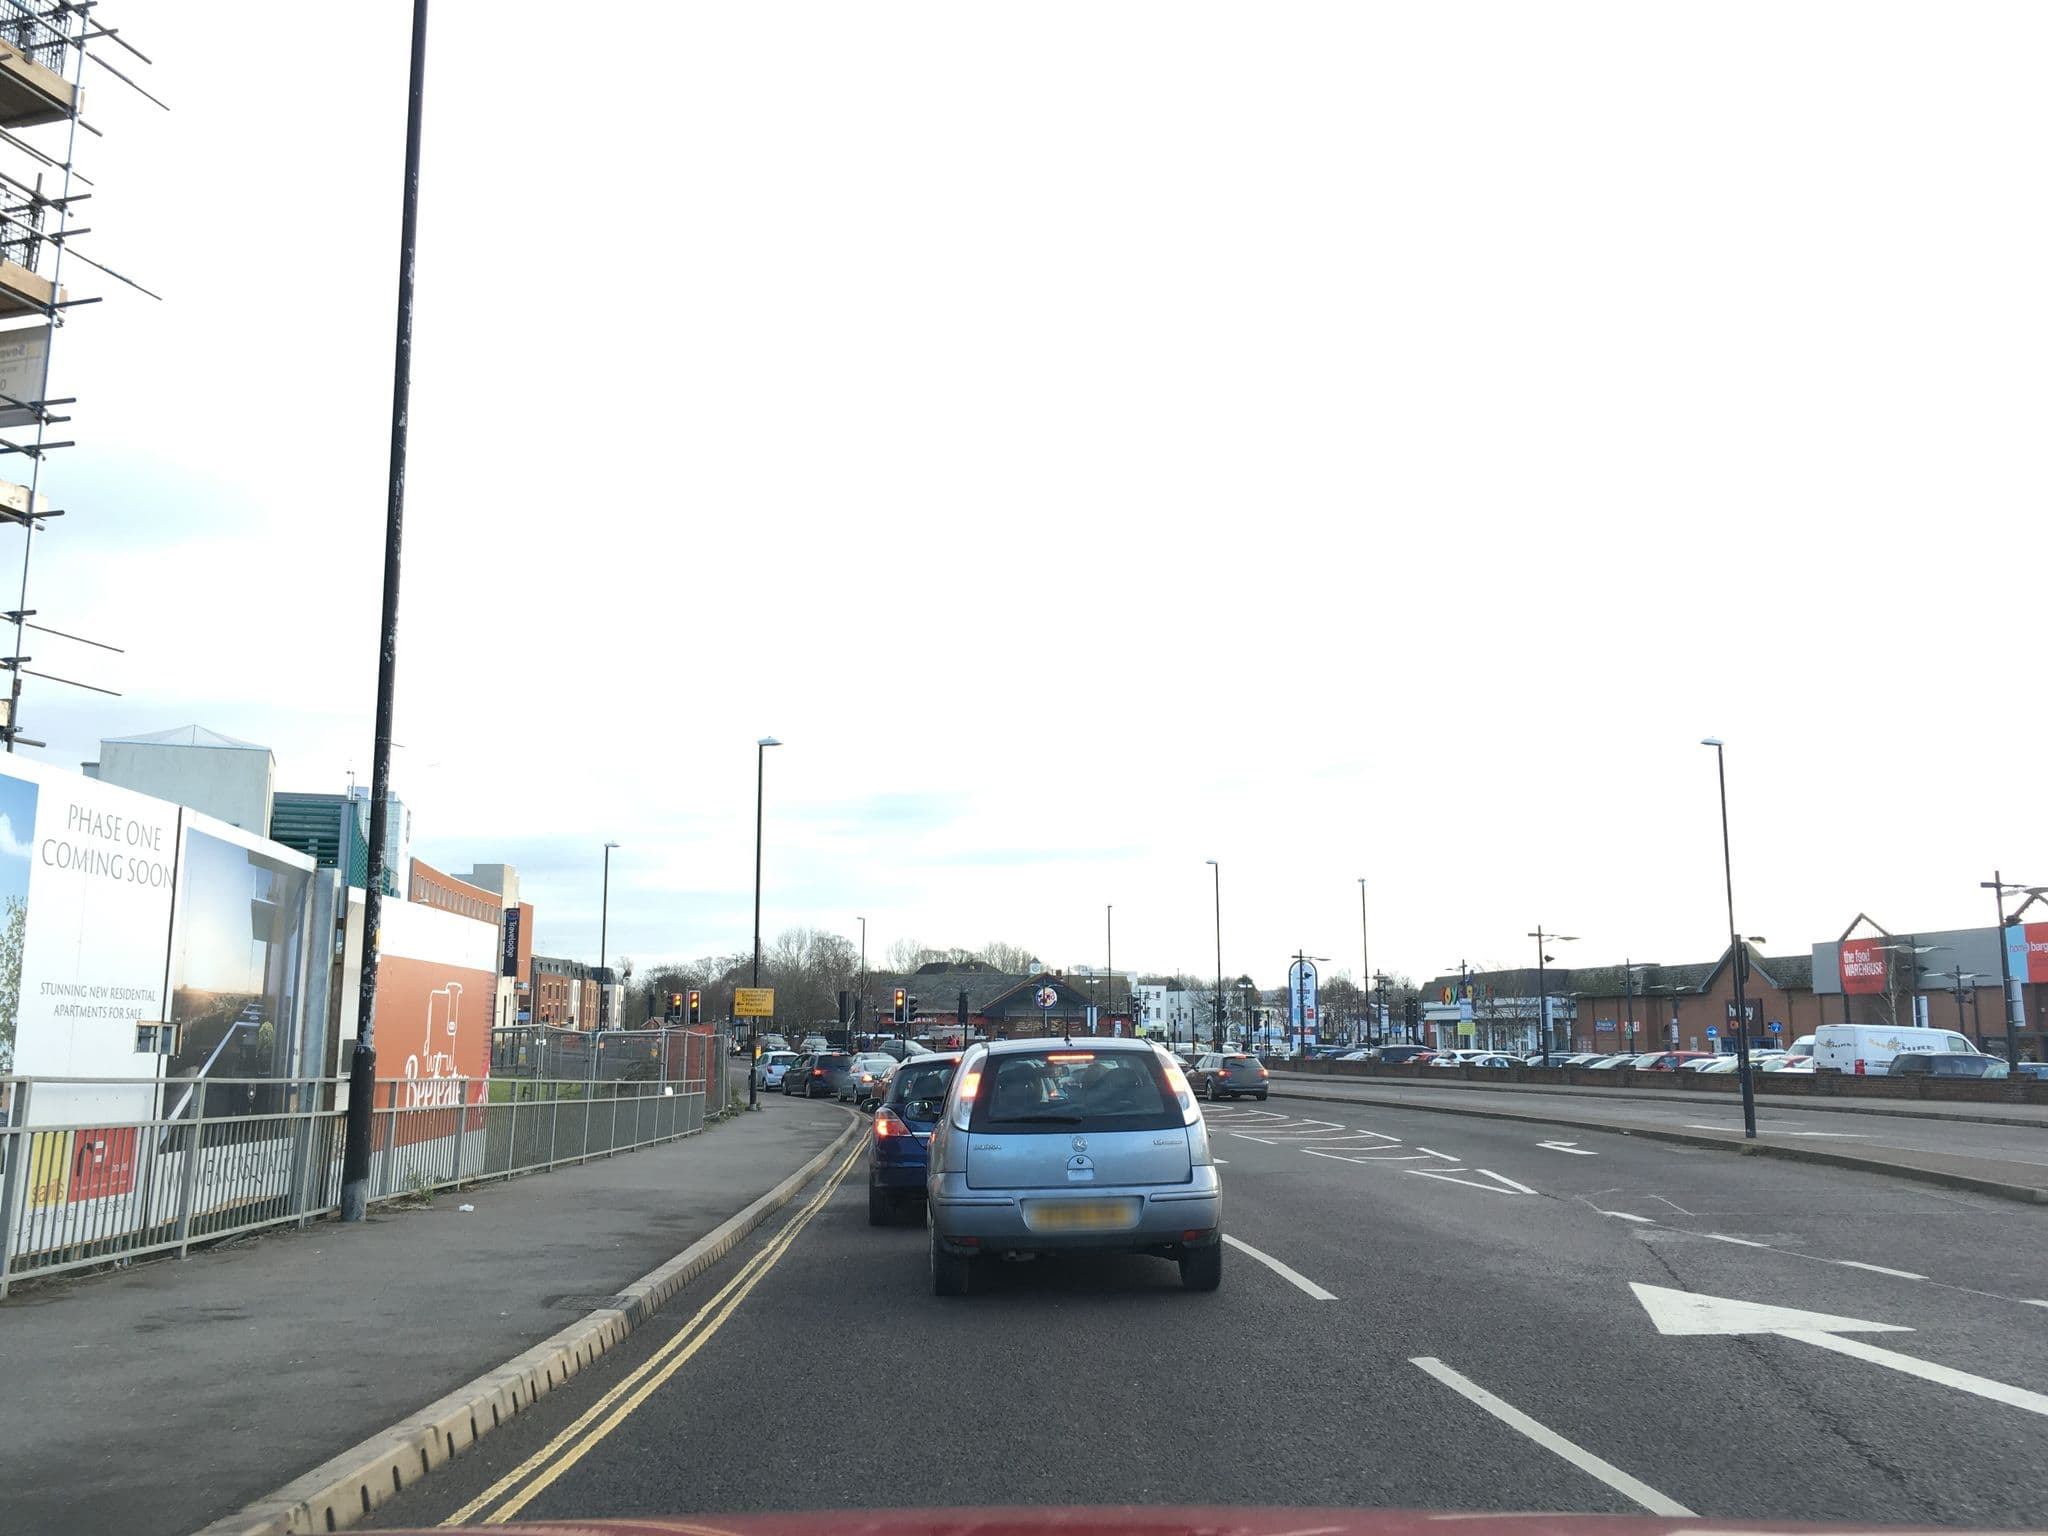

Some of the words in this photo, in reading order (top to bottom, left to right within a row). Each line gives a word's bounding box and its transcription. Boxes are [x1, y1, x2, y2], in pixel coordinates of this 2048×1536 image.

[67, 804, 122, 842] PHASE
[126, 820, 162, 852] ONE
[41, 838, 123, 880] COMING
[127, 857, 174, 890] SOON
[506, 920, 519, 958] Travelodge
[1843, 950, 1854, 963] the
[1855, 948, 1870, 962] food
[1844, 961, 1883, 977] WAREHOUSE
[40, 982, 88, 998] STUNNING
[89, 986, 109, 999] NEW
[110, 987, 156, 1002] RESIDENTIAL
[53, 1004, 108, 1019] APARTMENTS
[109, 1007, 125, 1019] FOR
[125, 1008, 143, 1020] SALE
